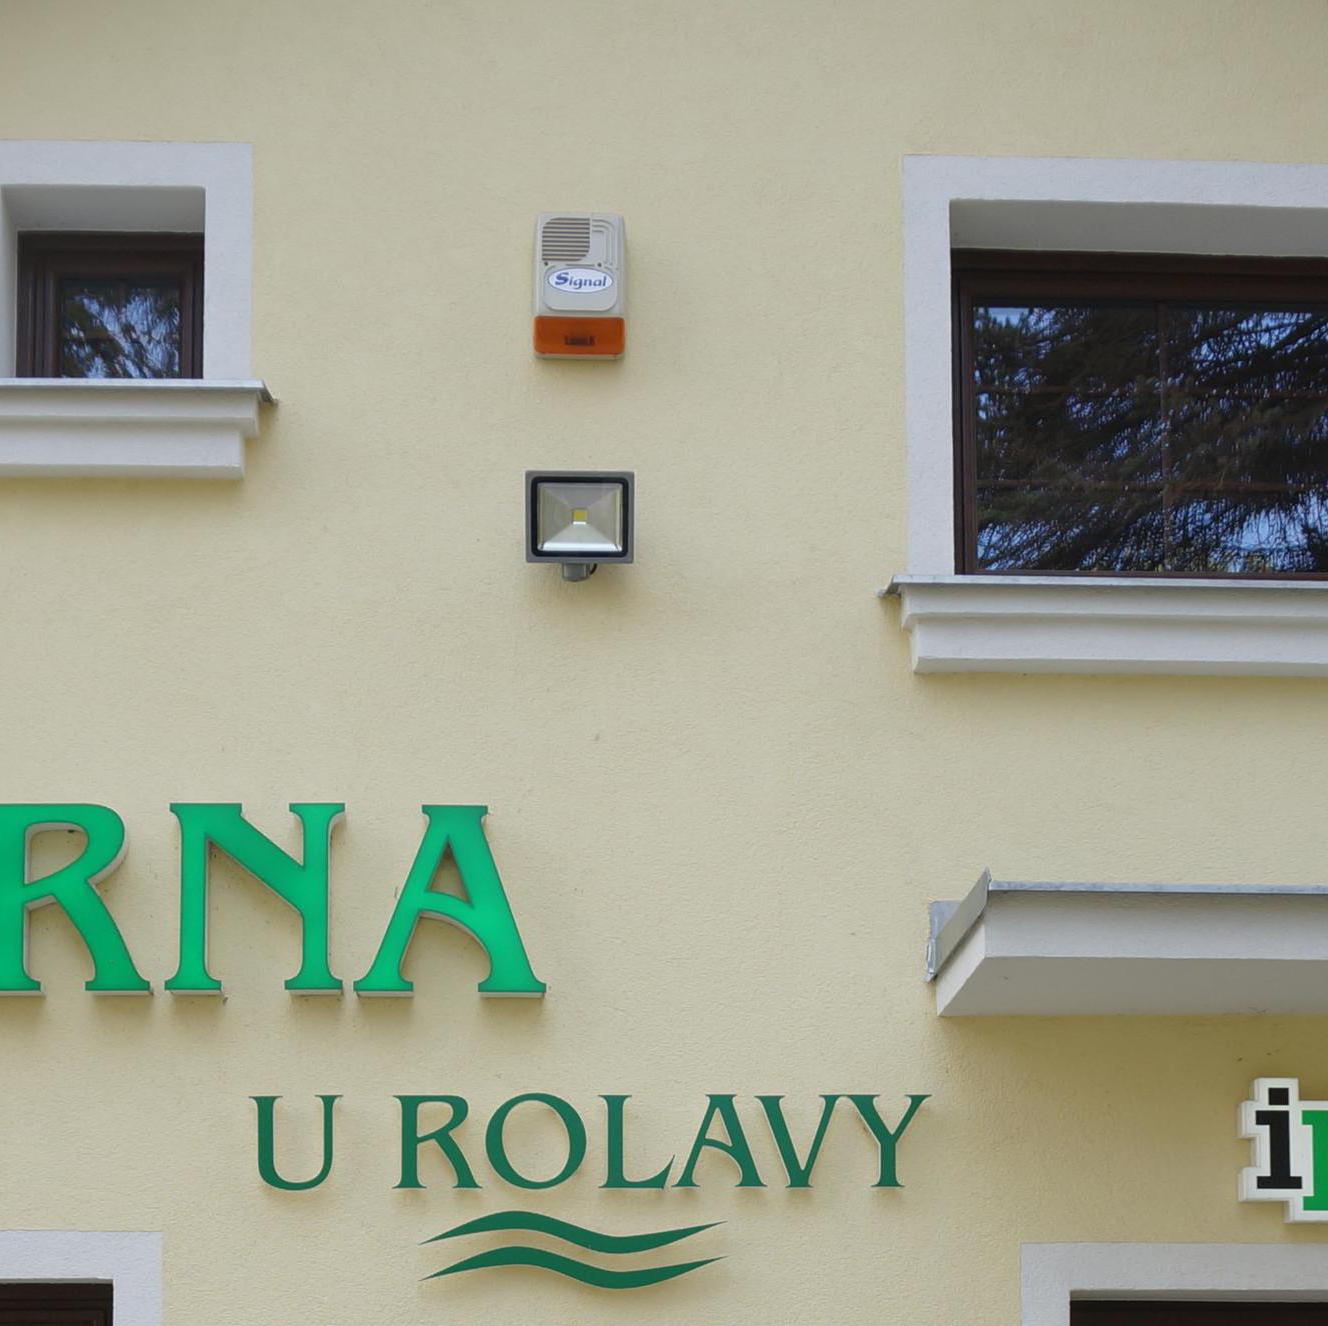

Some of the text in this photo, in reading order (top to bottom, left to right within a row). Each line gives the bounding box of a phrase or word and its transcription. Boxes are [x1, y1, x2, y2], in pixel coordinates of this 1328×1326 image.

[554, 271, 607, 290] Signal
[248, 1093, 932, 1191] U ROLAVY
